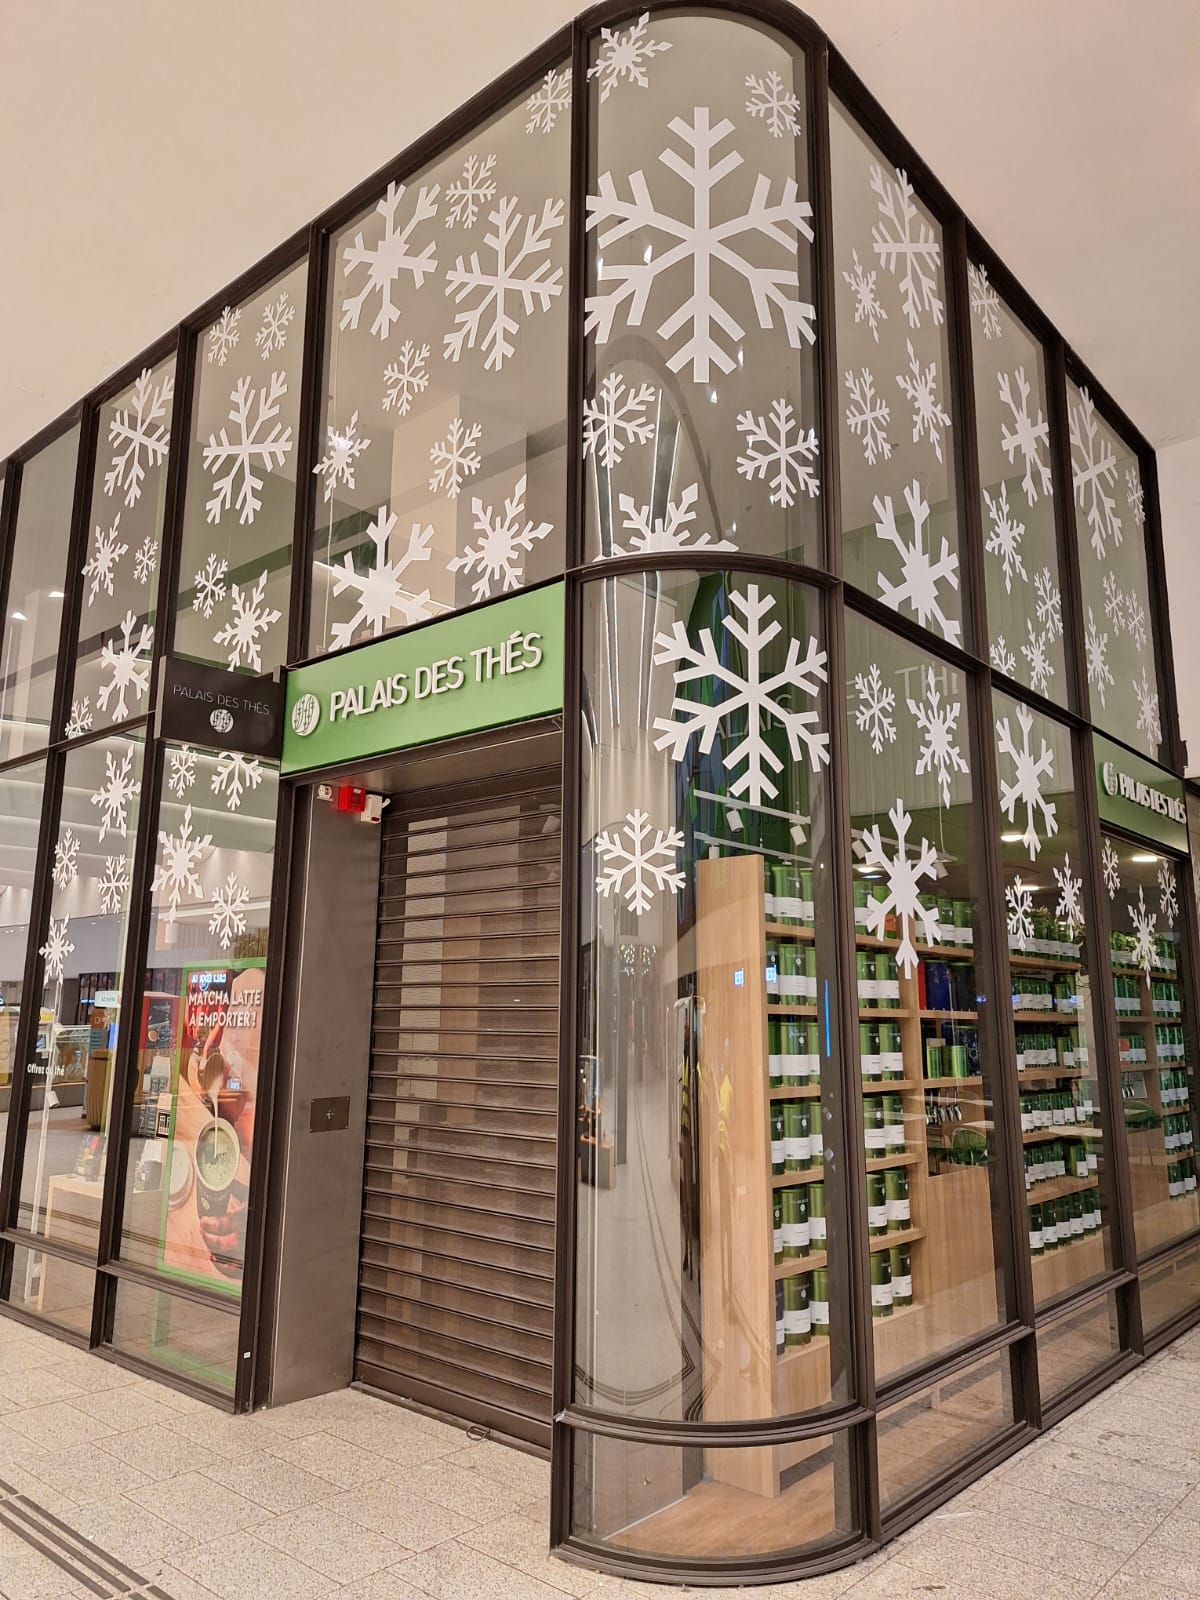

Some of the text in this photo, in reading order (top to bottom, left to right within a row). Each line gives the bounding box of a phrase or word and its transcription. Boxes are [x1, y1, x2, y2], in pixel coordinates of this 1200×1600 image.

[329, 630, 543, 722] PALAIS DES THÉS
[173, 683, 270, 715] PALAIS DES THÉS
[1119, 772, 1187, 824] PALAIS DES THÉS
[188, 988, 262, 1006] MATCHA LATTE
